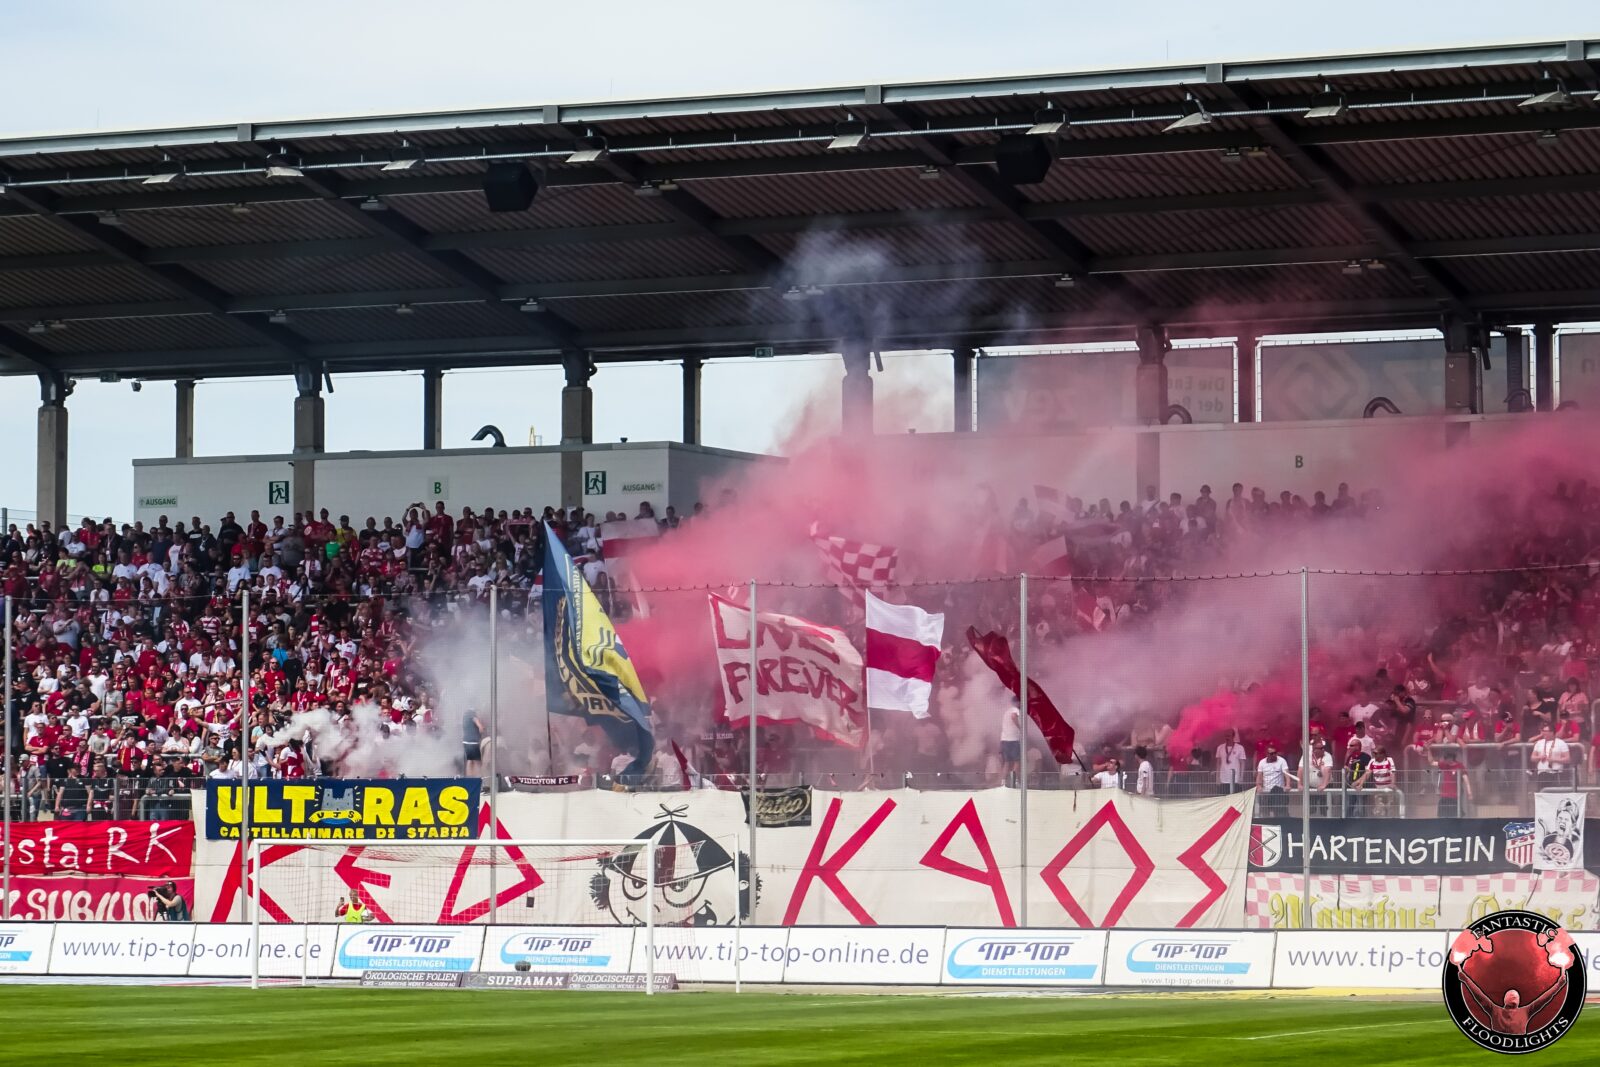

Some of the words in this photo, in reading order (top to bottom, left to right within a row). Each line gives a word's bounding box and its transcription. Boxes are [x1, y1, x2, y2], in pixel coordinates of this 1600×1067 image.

[1295, 455, 1304, 468] B
[434, 482, 442, 494] B
[622, 483, 656, 492] AUSGANG
[145, 497, 177, 506] AUSGANG
[723, 655, 869, 723] FREVER
[220, 826, 366, 839] CATELLAMMARE
[376, 827, 395, 838] DI
[407, 827, 470, 838] STABIA
[1287, 832, 1496, 865] HARTENSTEIN
[782, 797, 1242, 928] KAOS
[63, 937, 322, 963] www.tip-top-onlne.de
[368, 958, 447, 968] DIENSTLEISTUNGEN
[1154, 962, 1226, 972] DIENSTLEISTUNGEN
[365, 970, 425, 981] ÖKOLOGISCHE
[426, 972, 458, 981] FOLIEN
[981, 966, 1067, 977] DIENSTLEISTUNGEN
[486, 975, 565, 986] SUPRAMAX
[570, 972, 635, 983] ÖKOLOGISCHE
[636, 974, 671, 984] FOIEN
